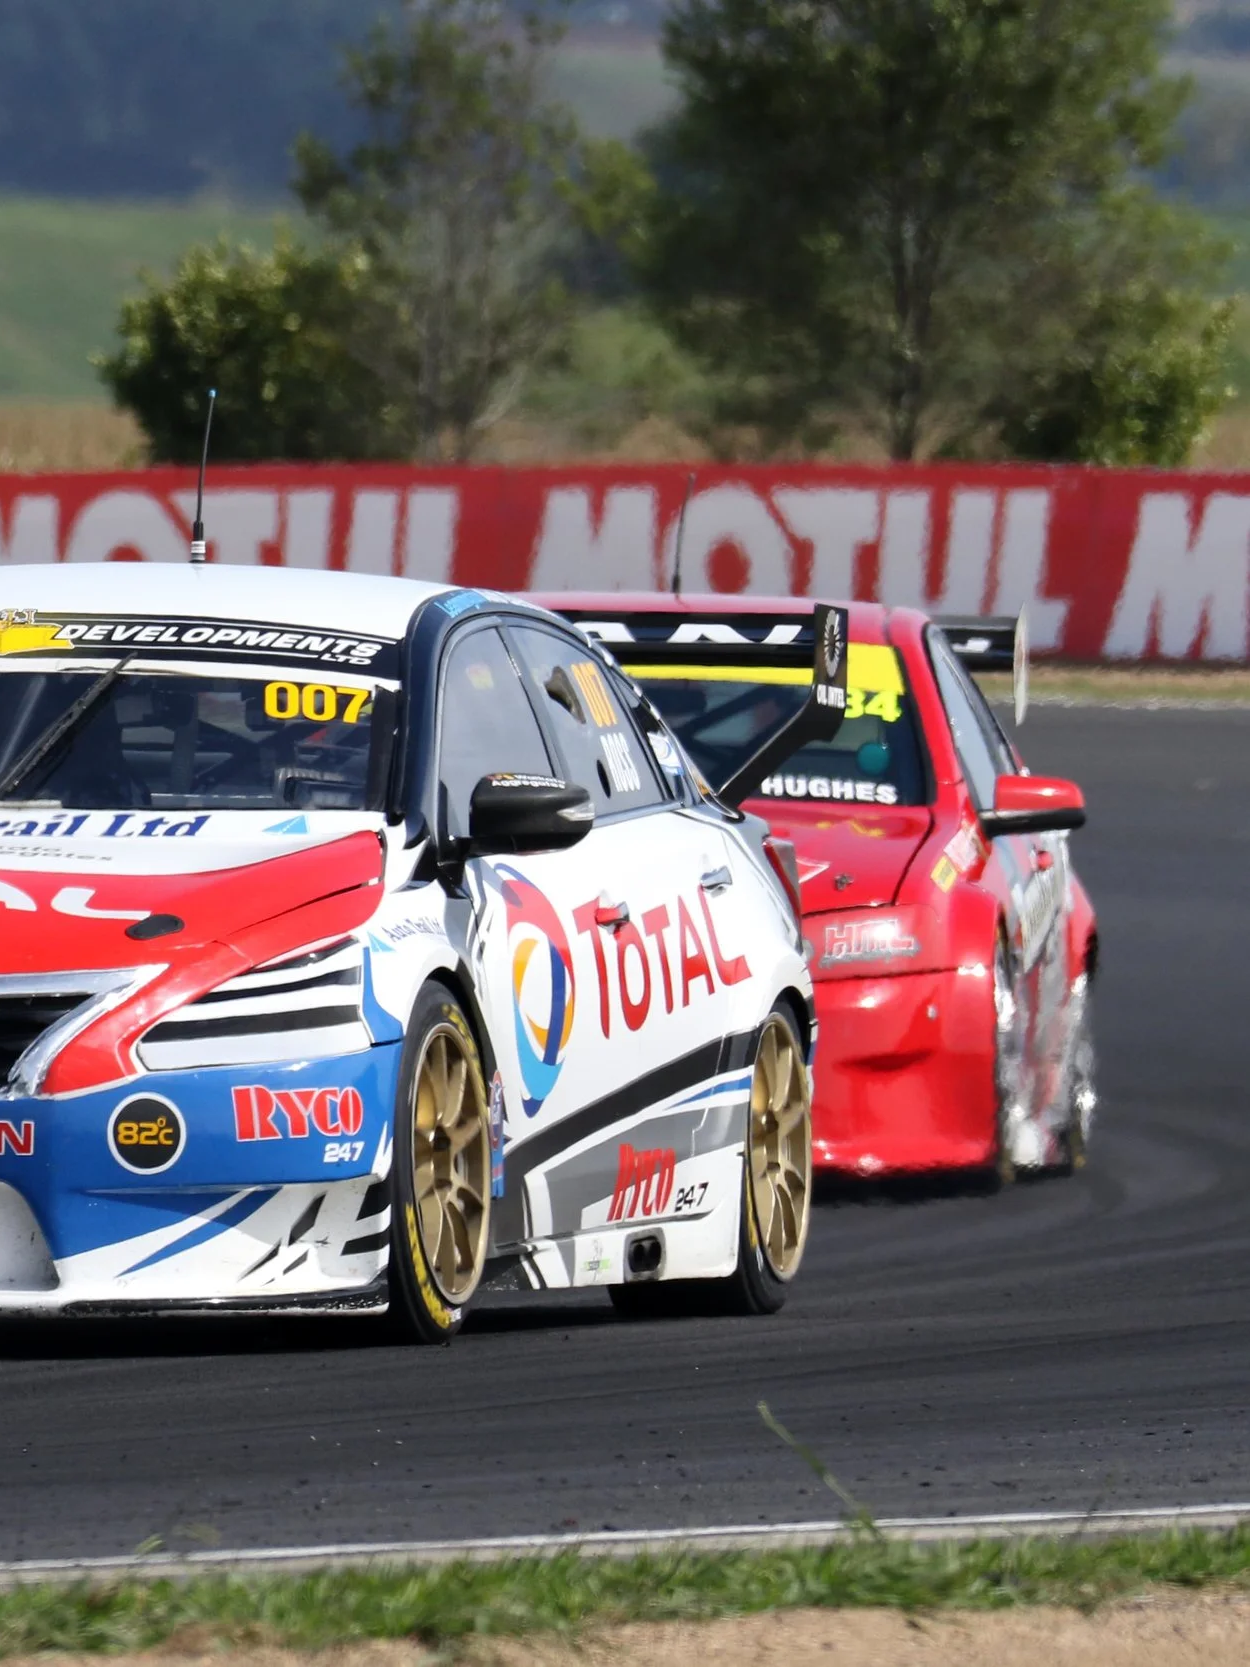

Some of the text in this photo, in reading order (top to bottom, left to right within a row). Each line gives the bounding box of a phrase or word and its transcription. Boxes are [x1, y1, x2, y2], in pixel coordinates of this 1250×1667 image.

[529, 484, 1070, 658] MOTUL
[54, 624, 383, 658] DEVELOPMENTS
[321, 652, 372, 667] LTD
[264, 682, 370, 724] 007
[571, 661, 618, 728] 007
[761, 774, 898, 805] HUGHES
[98, 813, 212, 838] Ltd
[572, 883, 752, 1040] TOTAL
[231, 1084, 364, 1142] RYCO
[323, 1141, 364, 1163] 247
[674, 1182, 710, 1213] 247
